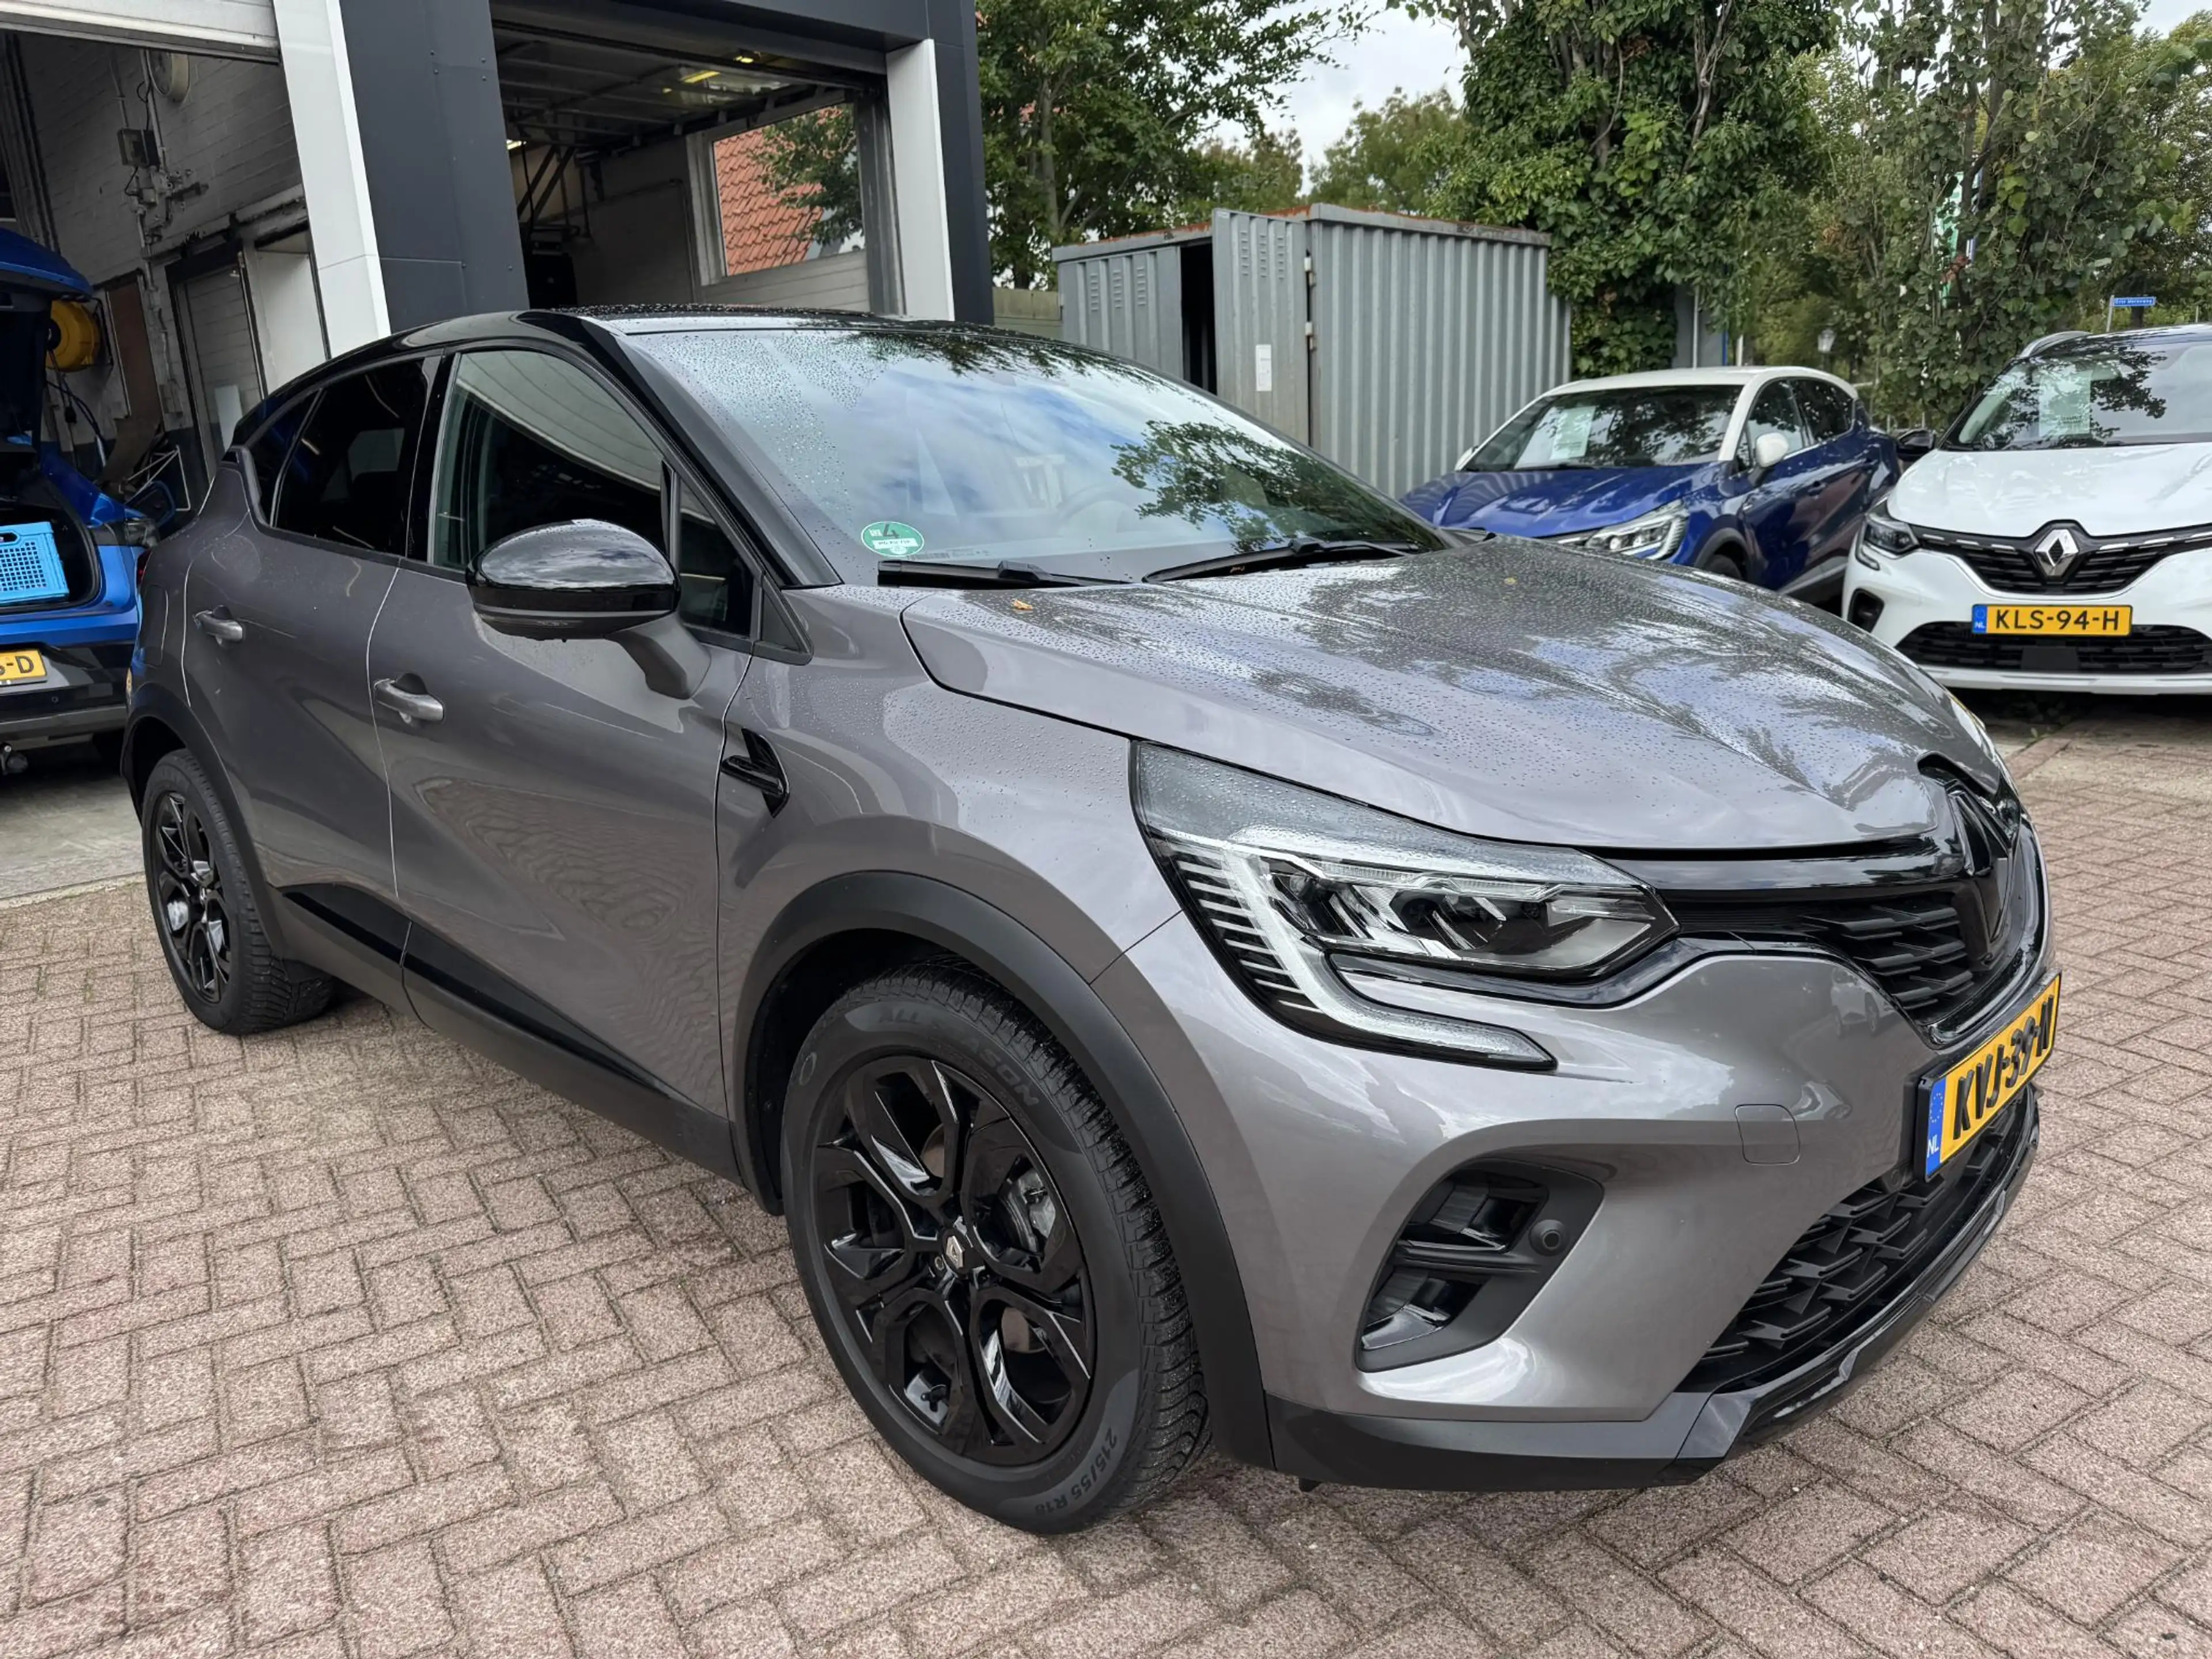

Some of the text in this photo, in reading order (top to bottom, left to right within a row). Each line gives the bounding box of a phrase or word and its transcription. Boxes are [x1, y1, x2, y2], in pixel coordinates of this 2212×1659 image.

[1995, 609, 2119, 631] KLS-94-H
[1926, 1134, 1940, 1158] NL
[1071, 1425, 1118, 1500] 215/55
